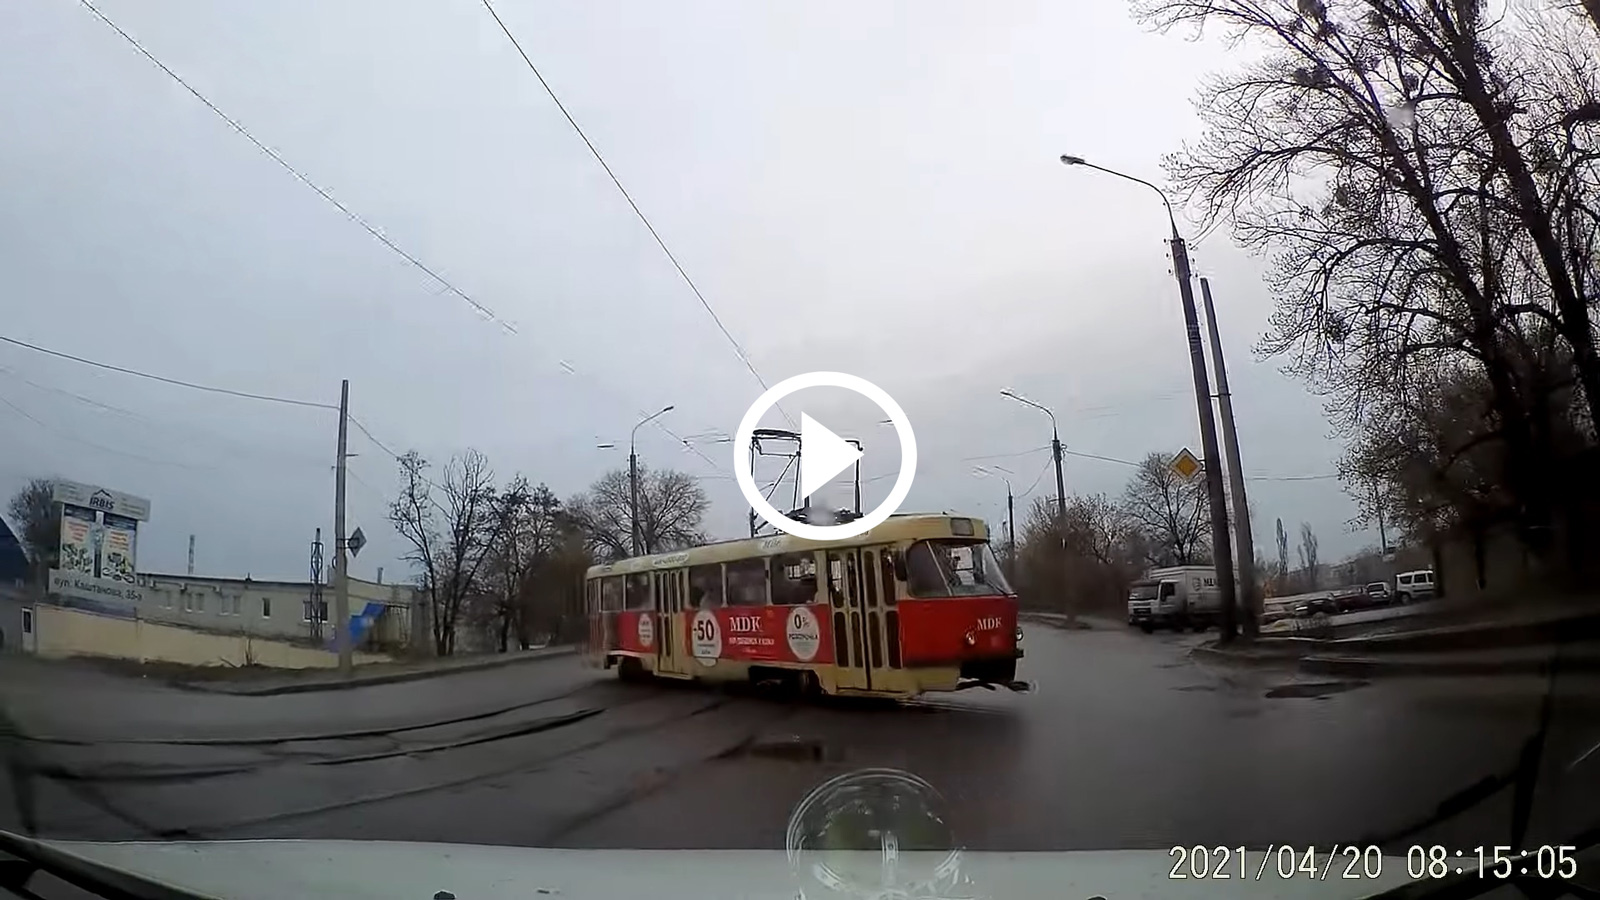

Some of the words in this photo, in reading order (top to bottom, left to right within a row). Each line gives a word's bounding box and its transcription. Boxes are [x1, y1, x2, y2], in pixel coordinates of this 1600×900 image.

[89, 498, 115, 510] IRBIS
[729, 616, 763, 632] MDK
[977, 617, 1002, 630] MDK
